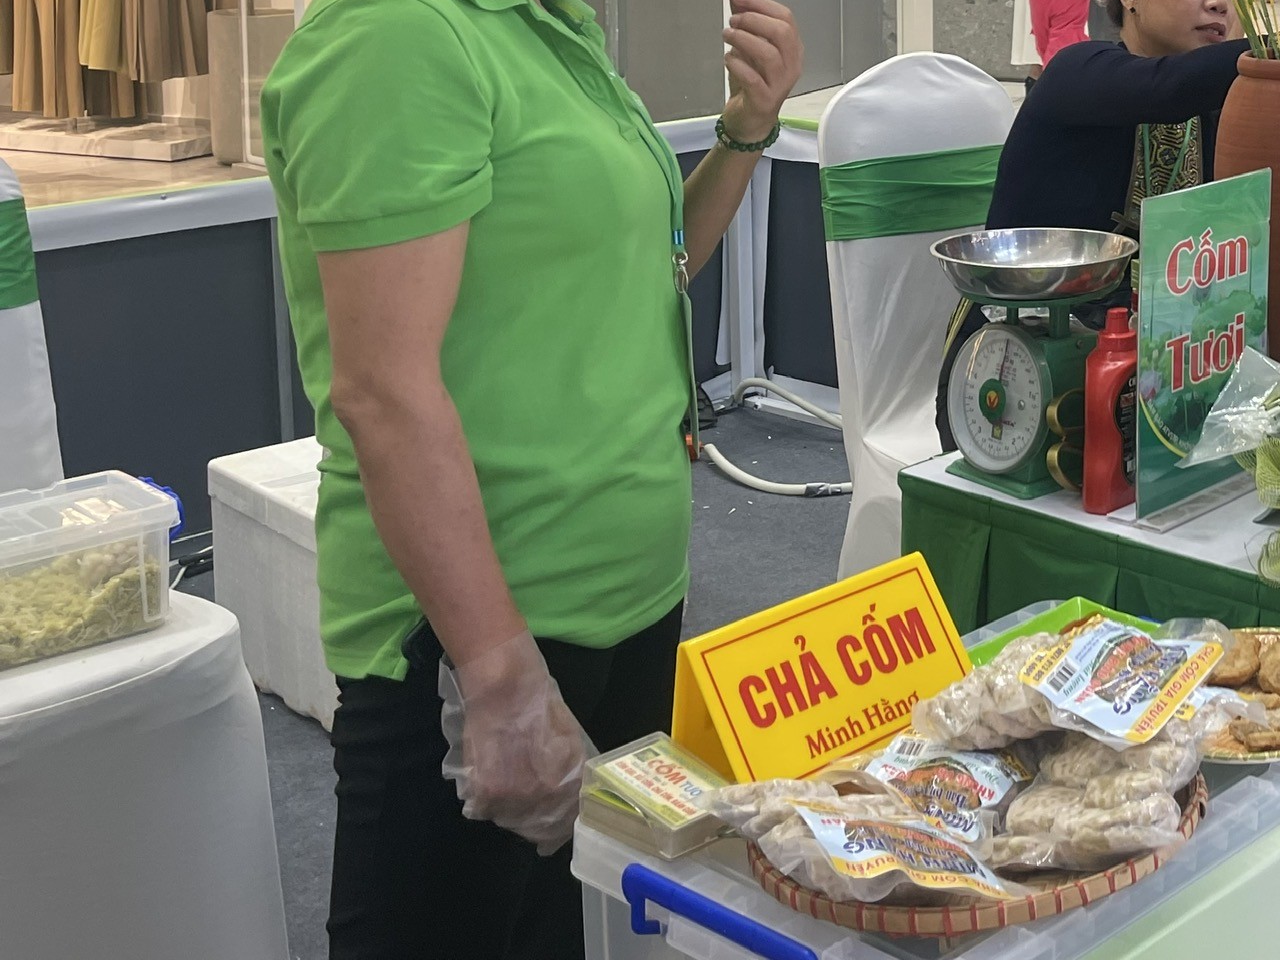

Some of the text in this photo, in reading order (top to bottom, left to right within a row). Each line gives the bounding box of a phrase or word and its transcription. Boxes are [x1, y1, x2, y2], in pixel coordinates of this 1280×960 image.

[1165, 227, 1248, 296] Cốm
[1165, 312, 1246, 392] Tươi
[738, 634, 838, 729] CHẢ
[836, 602, 937, 686] CỐM
[1164, 682, 1183, 699] GIA
[1180, 661, 1203, 686] CỐM
[805, 690, 920, 759] Minh Hằng
